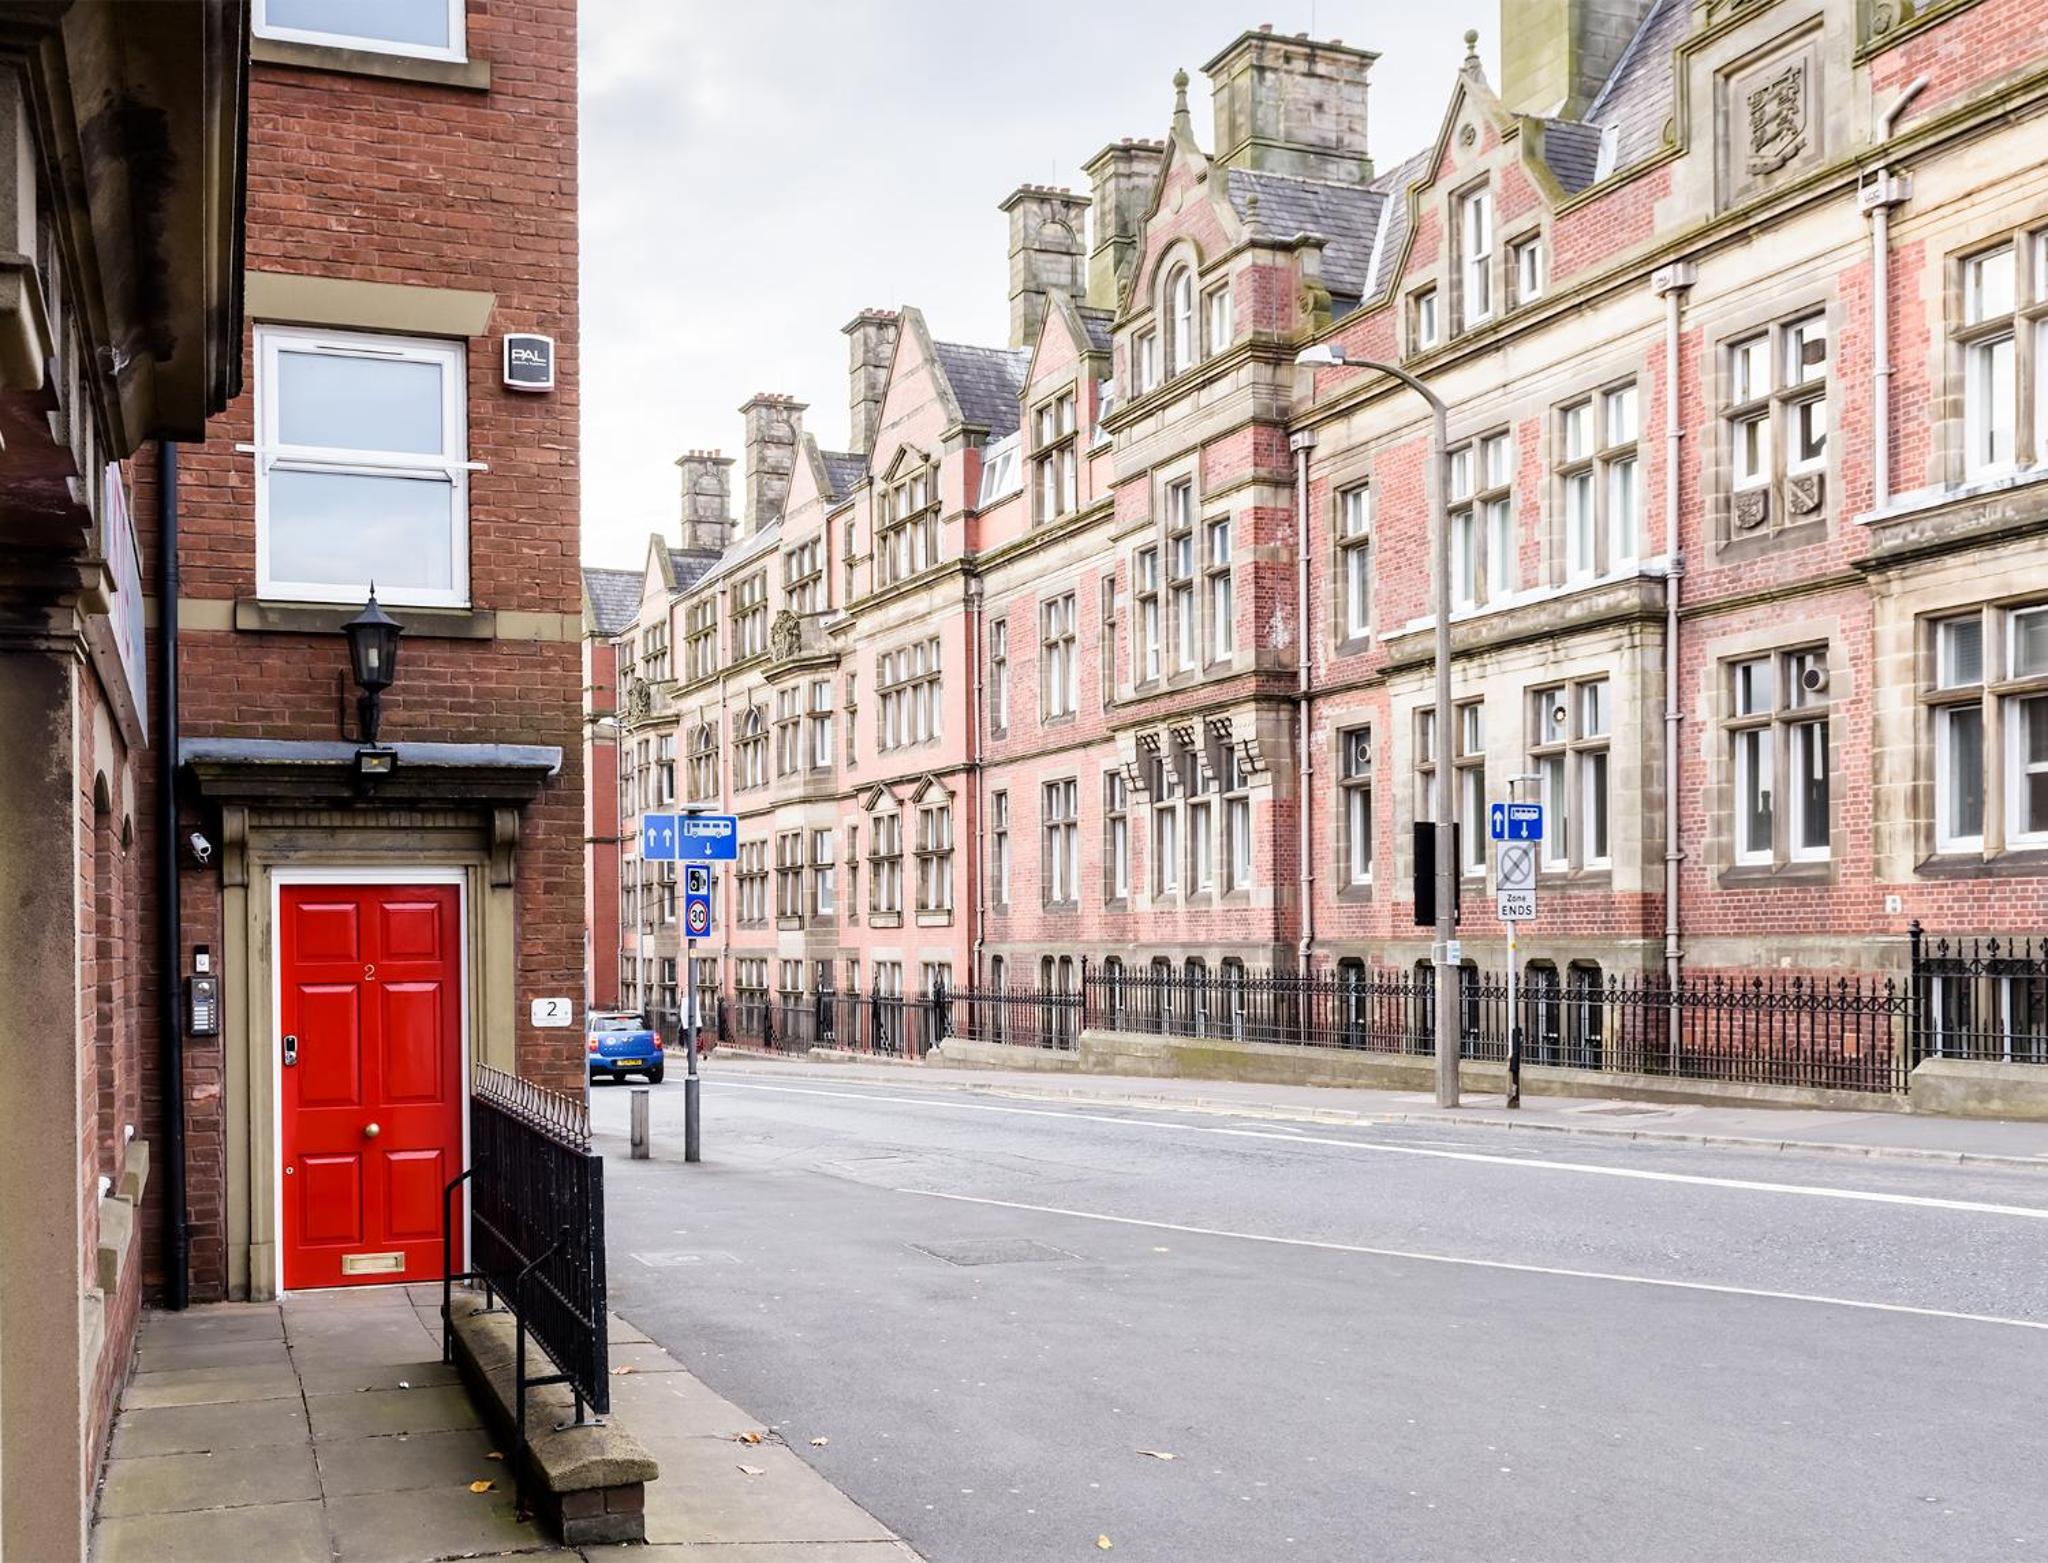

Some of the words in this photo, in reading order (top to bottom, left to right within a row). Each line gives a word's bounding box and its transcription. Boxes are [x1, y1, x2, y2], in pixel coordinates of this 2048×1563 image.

[511, 348, 547, 362] PAL
[691, 909, 705, 923] 30
[1501, 904, 1532, 916] ENDS
[364, 964, 376, 981] 2
[546, 1001, 558, 1017] 2
